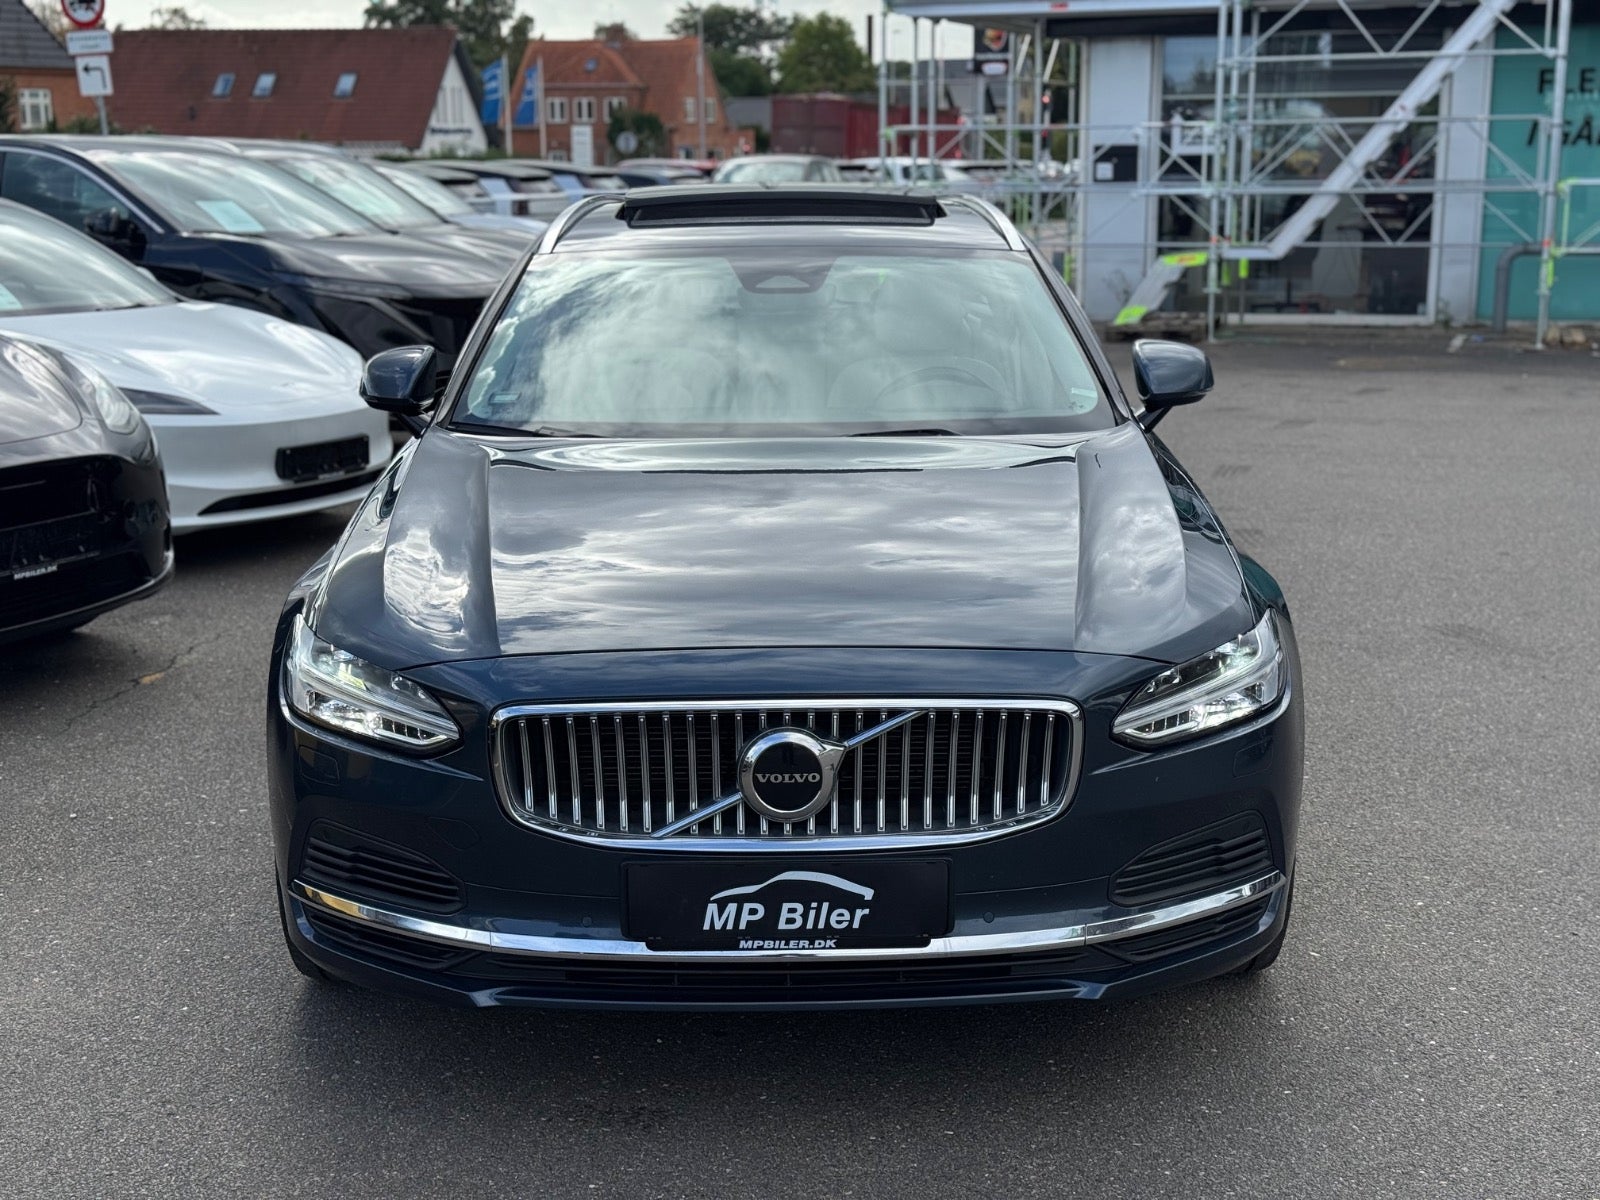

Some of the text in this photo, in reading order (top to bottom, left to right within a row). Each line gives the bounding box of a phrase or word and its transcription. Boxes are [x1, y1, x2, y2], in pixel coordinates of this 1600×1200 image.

[14, 565, 57, 580] MPBILER.DK
[755, 773, 820, 783] VOLVO
[702, 902, 869, 930] MP Biler
[739, 939, 836, 949] MPBILER.DK
